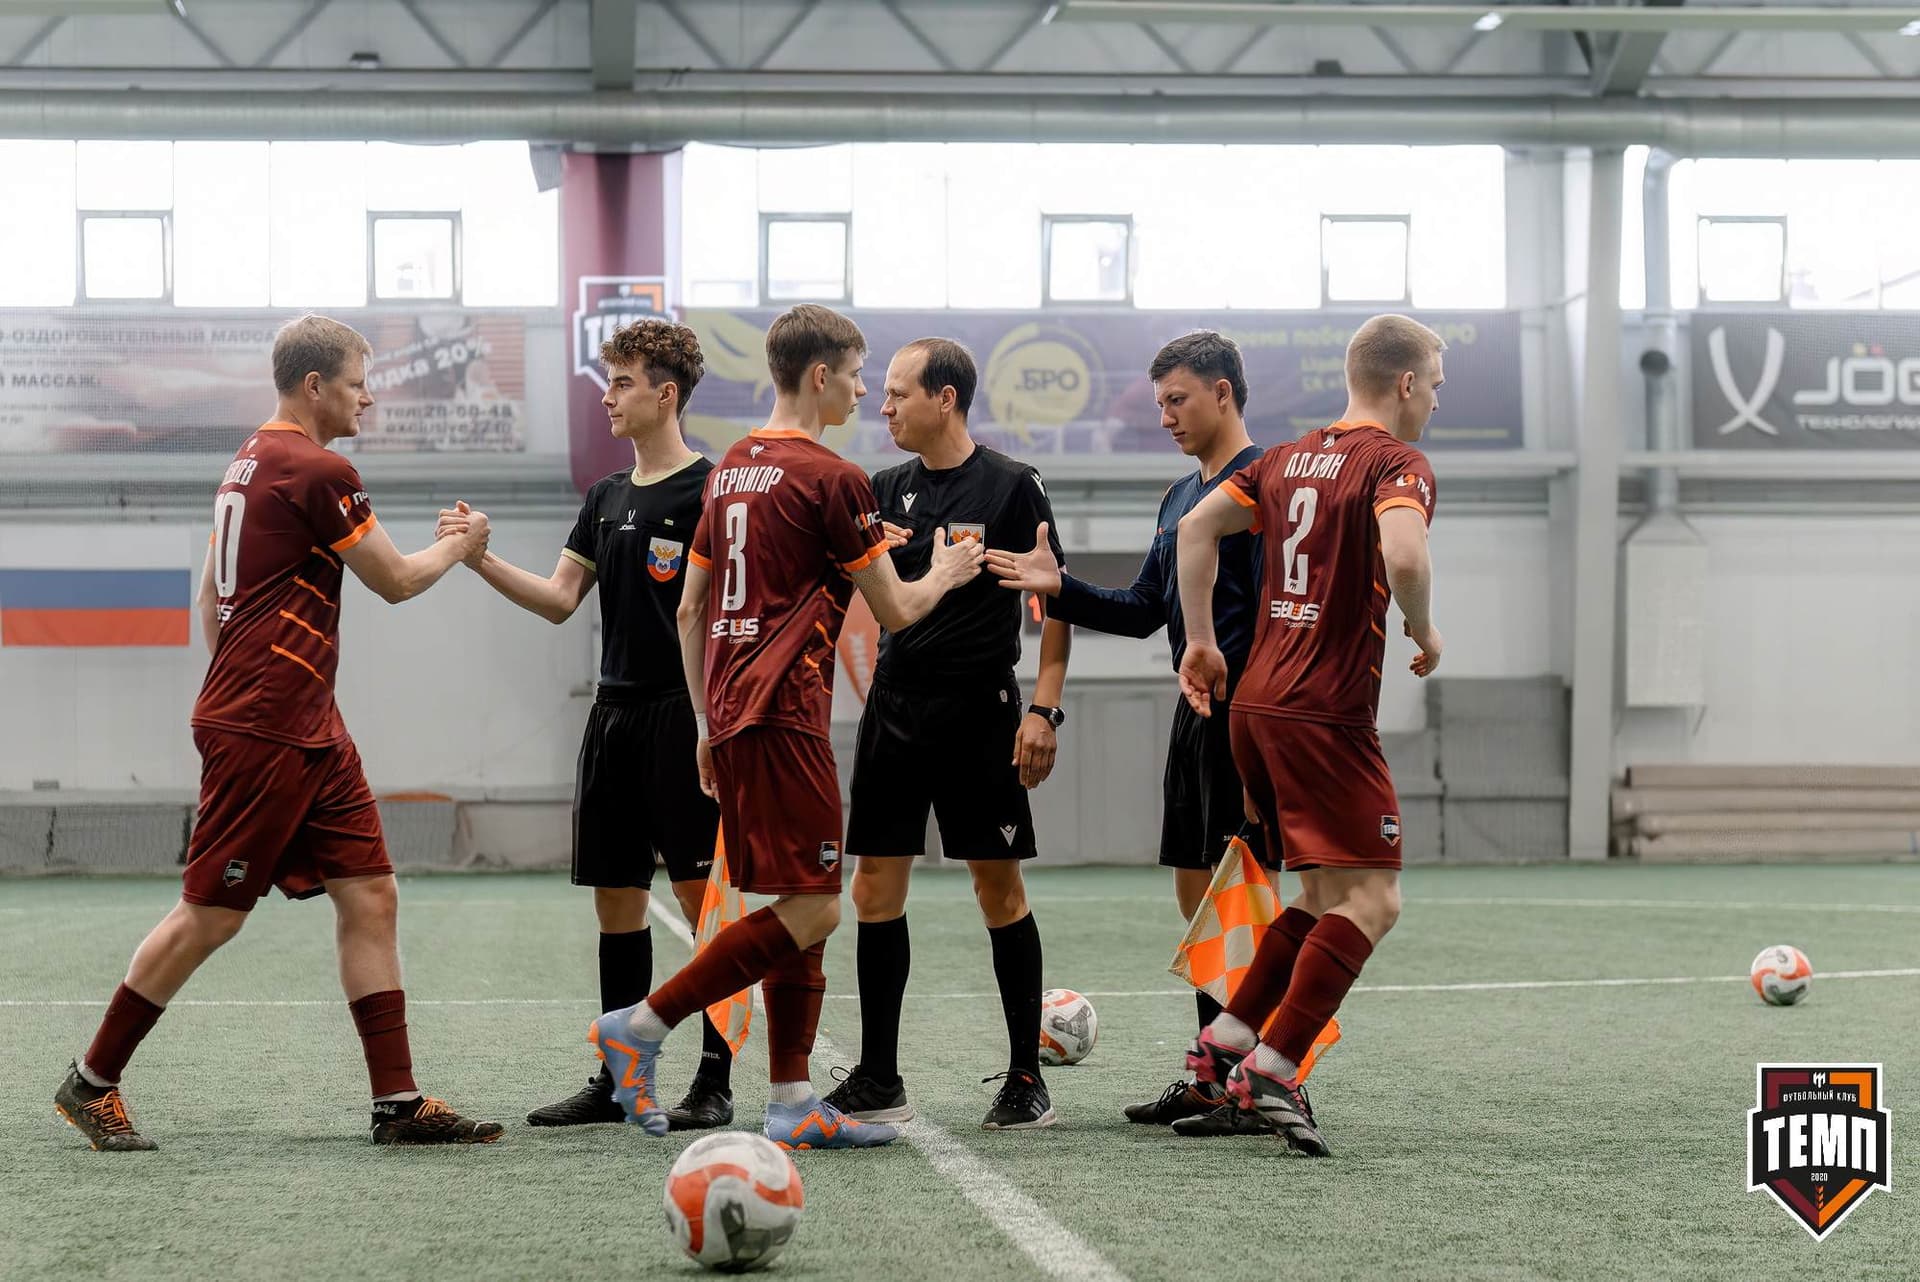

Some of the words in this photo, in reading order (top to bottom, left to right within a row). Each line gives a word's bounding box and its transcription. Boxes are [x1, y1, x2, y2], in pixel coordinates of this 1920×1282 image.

[211, 328, 277, 343] МАССА
[722, 502, 748, 611] 3
[1283, 486, 1318, 595] 2
